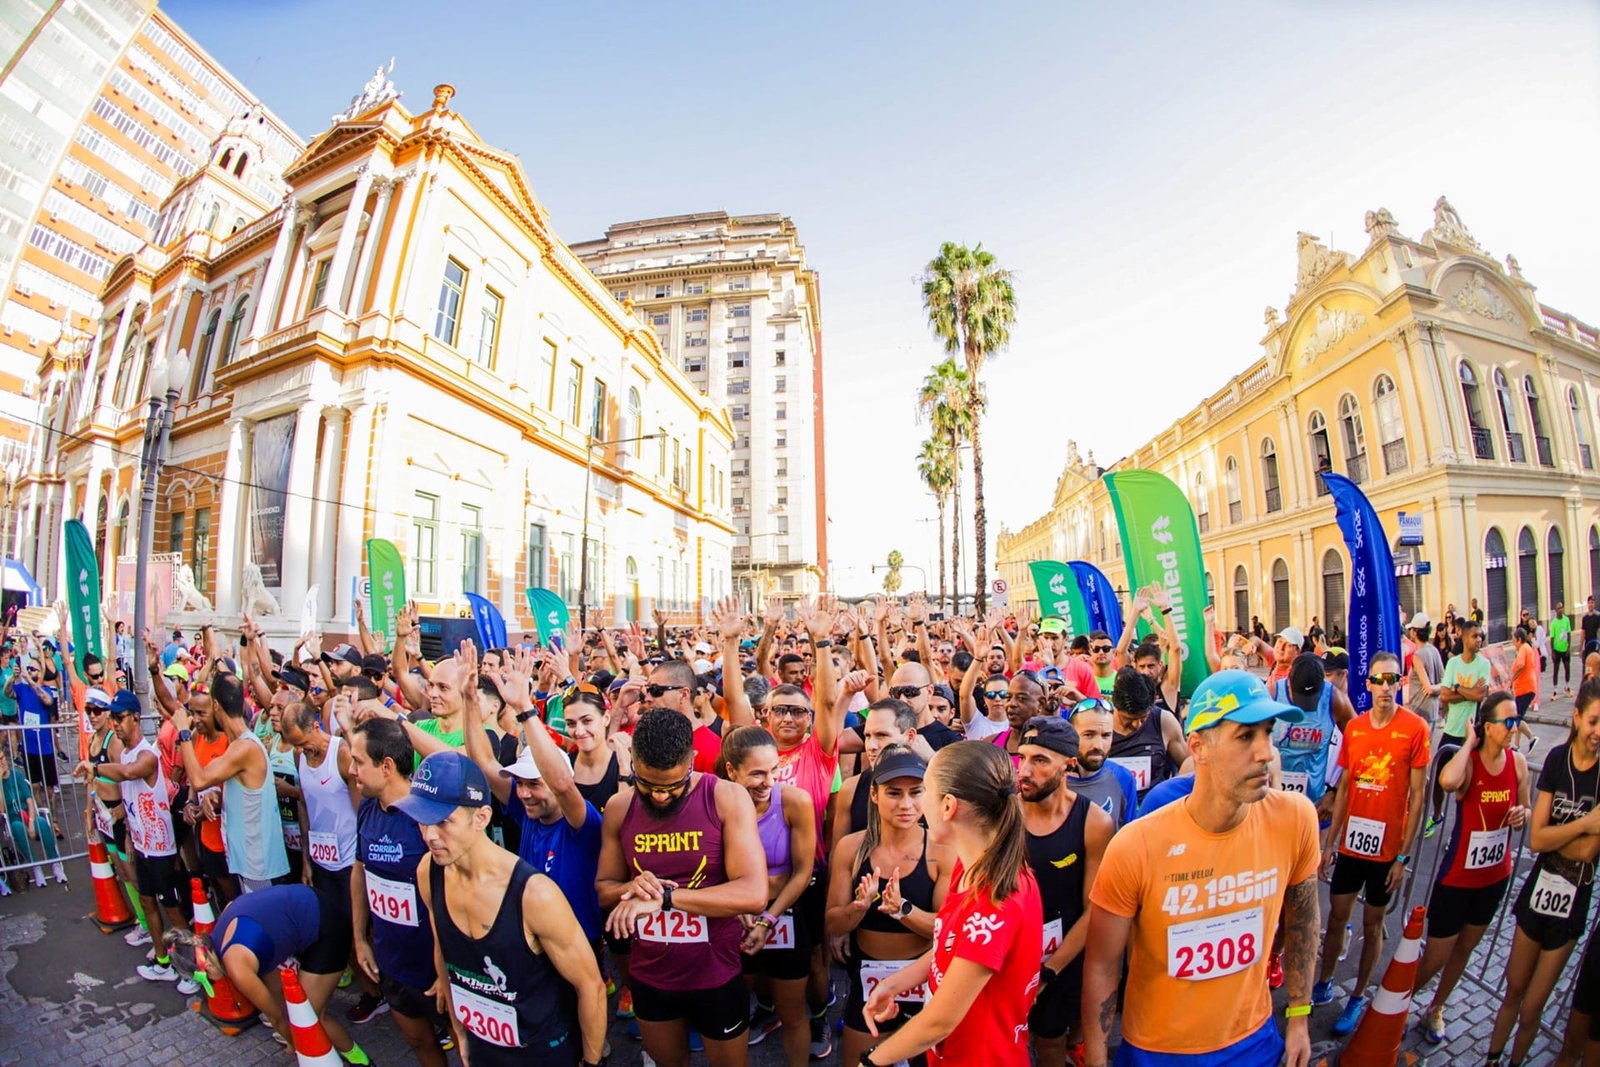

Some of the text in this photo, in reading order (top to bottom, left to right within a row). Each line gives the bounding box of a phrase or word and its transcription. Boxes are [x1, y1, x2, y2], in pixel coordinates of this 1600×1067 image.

[1354, 508, 1363, 549] Senac
[1353, 567, 1366, 597] Sesc
[1358, 614, 1368, 676] Sindicatos
[1290, 727, 1323, 741] GYM
[1480, 789, 1511, 803] SPRINT
[312, 843, 339, 862] 2092
[368, 842, 402, 854] CORRIDA
[634, 831, 703, 853] SPRINT
[1349, 830, 1380, 855] 1369
[1471, 842, 1504, 867] 1348
[367, 852, 401, 864] CRIATIVA
[370, 889, 411, 921] 2191
[1535, 887, 1571, 914] 1302
[643, 911, 702, 938] 2125
[1175, 932, 1256, 978] 2308
[460, 1005, 516, 1047] 2300
